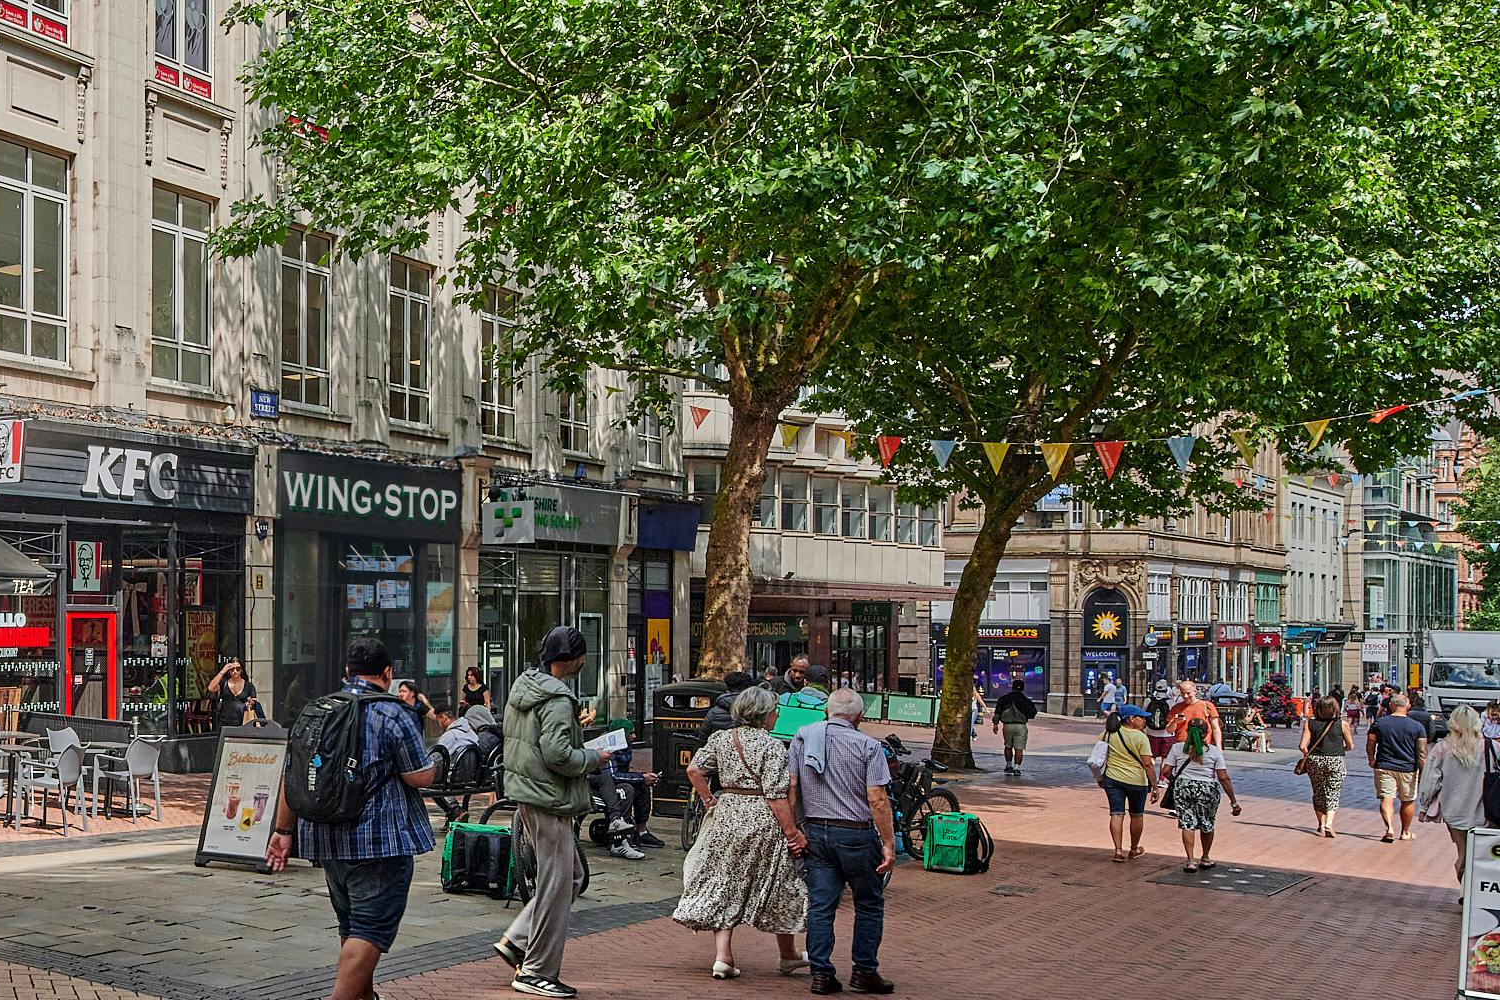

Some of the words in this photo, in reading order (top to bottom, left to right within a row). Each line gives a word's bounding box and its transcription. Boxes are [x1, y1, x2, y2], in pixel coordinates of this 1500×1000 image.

[258, 395, 271, 404] NEW
[254, 403, 275, 413] STREET
[83, 445, 178, 500] KFC
[511, 493, 558, 512] YSHIRE
[12, 579, 35, 594] TEA
[856, 615, 888, 623] ITALIAN
[1004, 629, 1038, 637] SLOTS
[1480, 881, 1500, 893] FA
